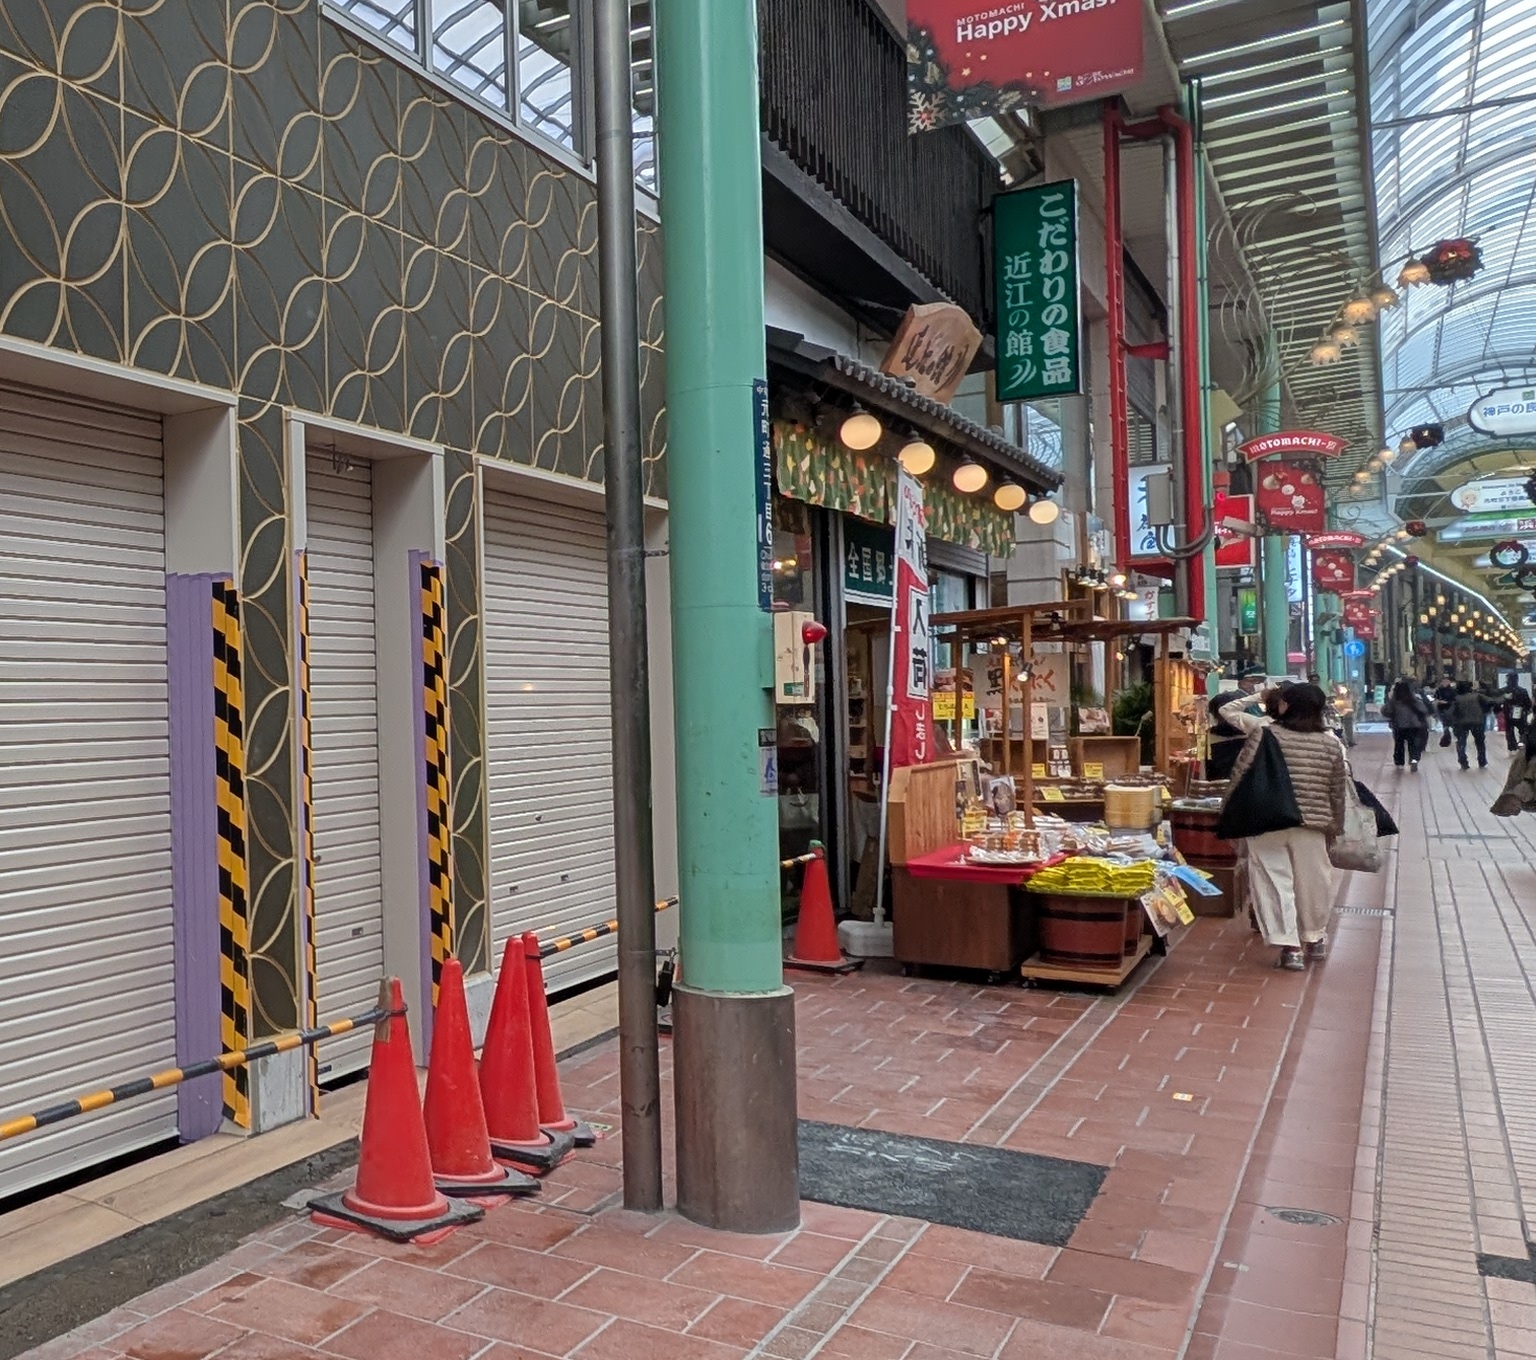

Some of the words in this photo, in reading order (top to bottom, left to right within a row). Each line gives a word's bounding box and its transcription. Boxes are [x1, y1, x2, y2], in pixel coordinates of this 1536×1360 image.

[955, 7, 1032, 44] Happy
[956, 1, 1026, 27] MOTOMACHI
[1003, 251, 1036, 357] 近江の館
[1037, 192, 1072, 387] こだわりの食品
